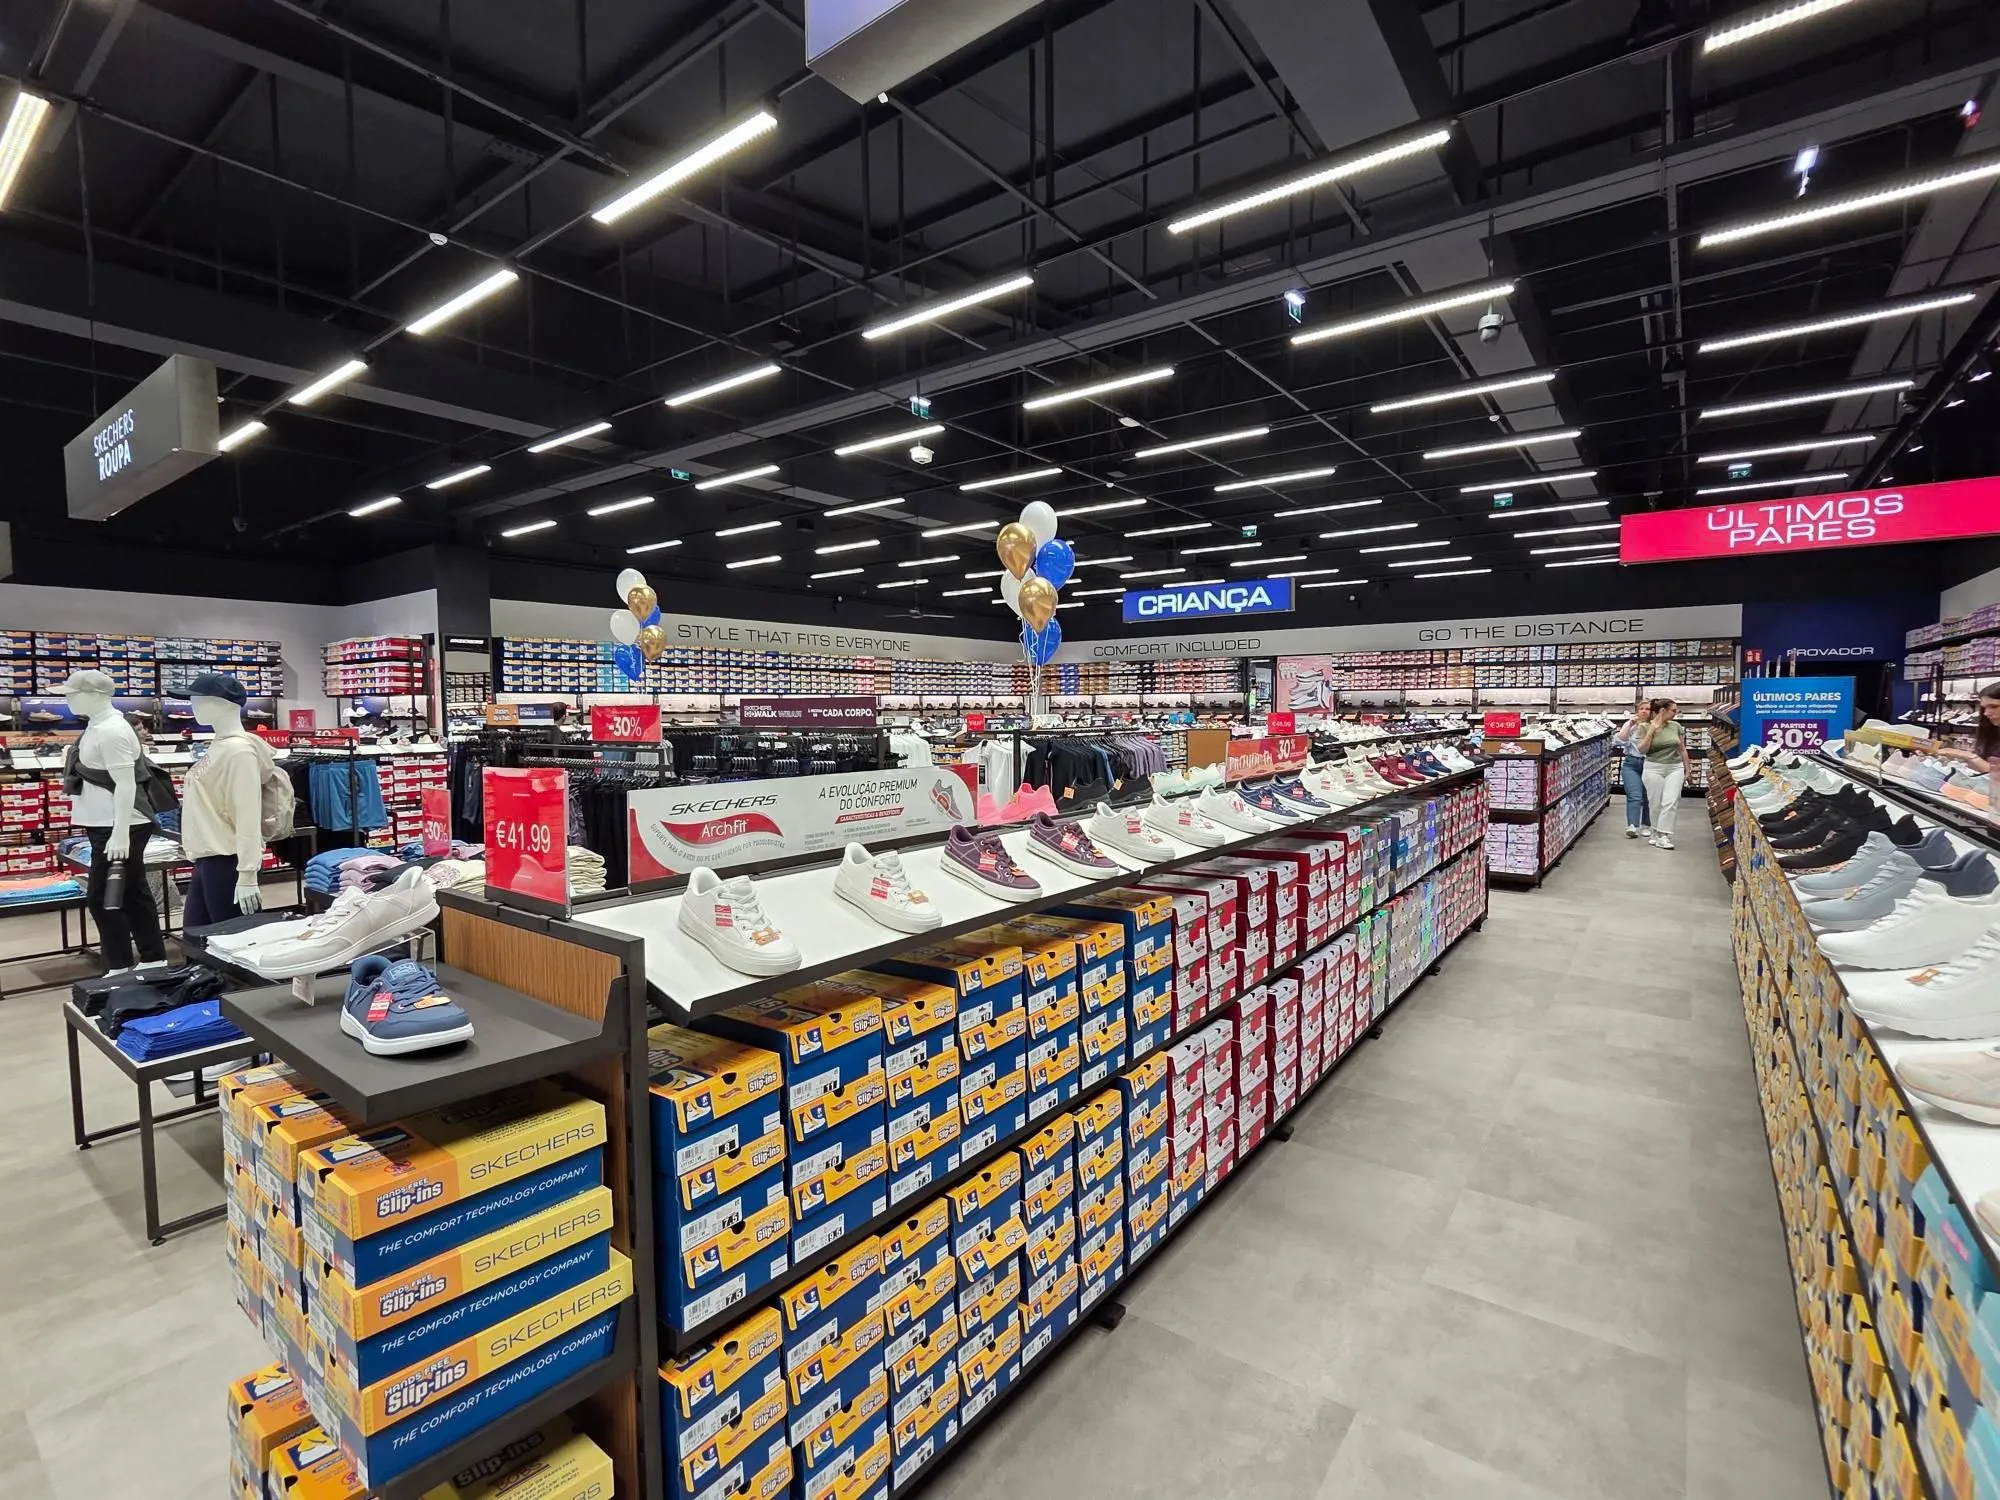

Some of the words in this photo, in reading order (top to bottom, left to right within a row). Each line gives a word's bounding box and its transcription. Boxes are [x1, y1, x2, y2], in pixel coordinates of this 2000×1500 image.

[94, 408, 134, 457] SKECHERS
[99, 439, 132, 481] ROUPA
[1708, 494, 1904, 531] ÚLTIMOS
[1729, 518, 1876, 548] PARES
[1138, 586, 1272, 616] CRIANÇA
[677, 624, 740, 641] STYLE
[745, 629, 792, 644] THAT
[797, 633, 831, 647] FITS
[836, 636, 911, 651] EVERYONE
[1419, 628, 1451, 642] GO
[1460, 626, 1505, 640] THE
[1514, 618, 1644, 638] DISTANCE
[1093, 643, 1170, 657] COMFORT
[1175, 638, 1261, 653] INCLUDED
[1753, 691, 1801, 702] ÚLTIMOS
[1805, 692, 1841, 701] PARES
[608, 716, 642, 737] -30%
[823, 708, 844, 718] CADA
[845, 708, 874, 718] CORPO.
[1767, 728, 1823, 748] 30%
[819, 787, 826, 799] A
[828, 780, 877, 799] EVOLUÇÃO
[878, 778, 918, 793] PREMIUM
[839, 798, 853, 811] DO
[855, 793, 901, 808] CONFORTO
[669, 794, 778, 816] SKECHERS
[424, 820, 449, 843] -30%
[496, 820, 551, 854] €41.99
[853, 1014, 880, 1033] Slip-ins
[748, 1071, 777, 1093] Slip-ins
[856, 1085, 883, 1106] Slip-ins
[470, 1123, 595, 1180] SKECHERS
[752, 1145, 781, 1167] Slip-ins
[856, 1157, 883, 1179] Slip-ins
[376, 1185, 407, 1202] HANDS
[407, 1177, 429, 1190] FREE
[378, 1182, 443, 1218] Slip-ins
[378, 1239, 402, 1257] THE
[404, 1215, 463, 1245] COMFORT
[465, 1185, 539, 1221] TECHNOLOGY
[538, 1165, 588, 1191] COMPANY
[474, 1208, 601, 1273] SKECHERS
[757, 1217, 785, 1242] Slip-ins
[851, 1255, 879, 1281] Slip-ins
[379, 1285, 410, 1302] HANDS
[410, 1274, 433, 1287] FREE
[380, 1277, 446, 1318] Slip-ins
[381, 1335, 405, 1354] THE
[407, 1307, 467, 1341] COMFORT
[469, 1272, 542, 1313] TECHNOLOGY
[543, 1249, 594, 1279] COMPANY
[490, 1279, 622, 1358] SKECHERS
[748, 1332, 778, 1360] Slip-ins
[854, 1323, 882, 1351] Slip-ins
[384, 1371, 423, 1397] HANDS
[424, 1356, 451, 1374] FREE
[385, 1359, 468, 1416] Slip-ins
[392, 1428, 417, 1450] THE
[420, 1393, 482, 1434] COMFORT
[484, 1349, 561, 1397] TECHNOLOGY
[561, 1320, 615, 1355] COMPANY
[753, 1401, 782, 1431] Slip-ins
[762, 1466, 790, 1497] Slip-ins
